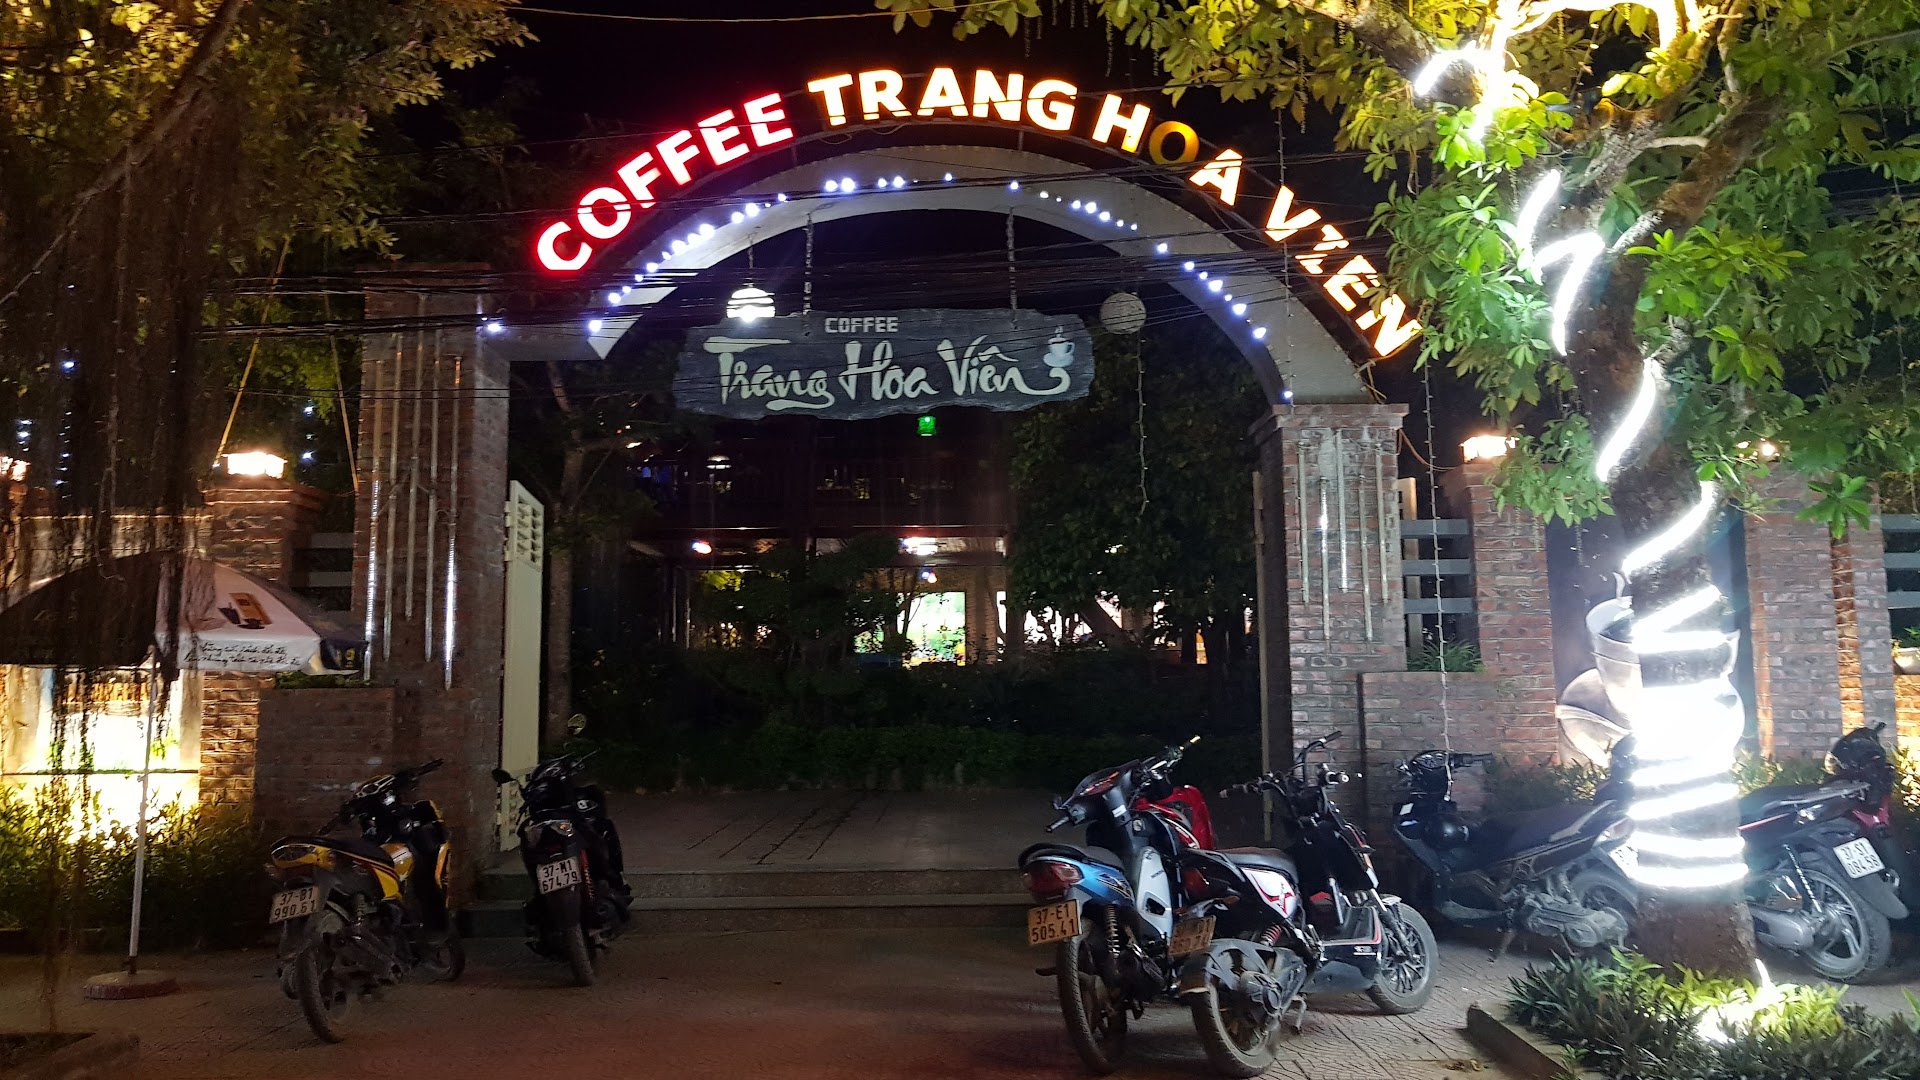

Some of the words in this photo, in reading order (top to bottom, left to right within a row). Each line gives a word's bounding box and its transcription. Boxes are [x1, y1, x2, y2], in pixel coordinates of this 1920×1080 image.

[537, 92, 794, 271] COFFEE
[807, 67, 1078, 131] TRANG
[1092, 93, 1243, 207] HOA
[824, 316, 899, 334] COFFEE
[703, 335, 835, 411] Trang
[838, 339, 939, 401] Hoa
[542, 859, 573, 878] 37-M1
[542, 871, 578, 892] 674.79
[1035, 903, 1069, 925] 37-E1
[1031, 918, 1076, 943] 505.41
